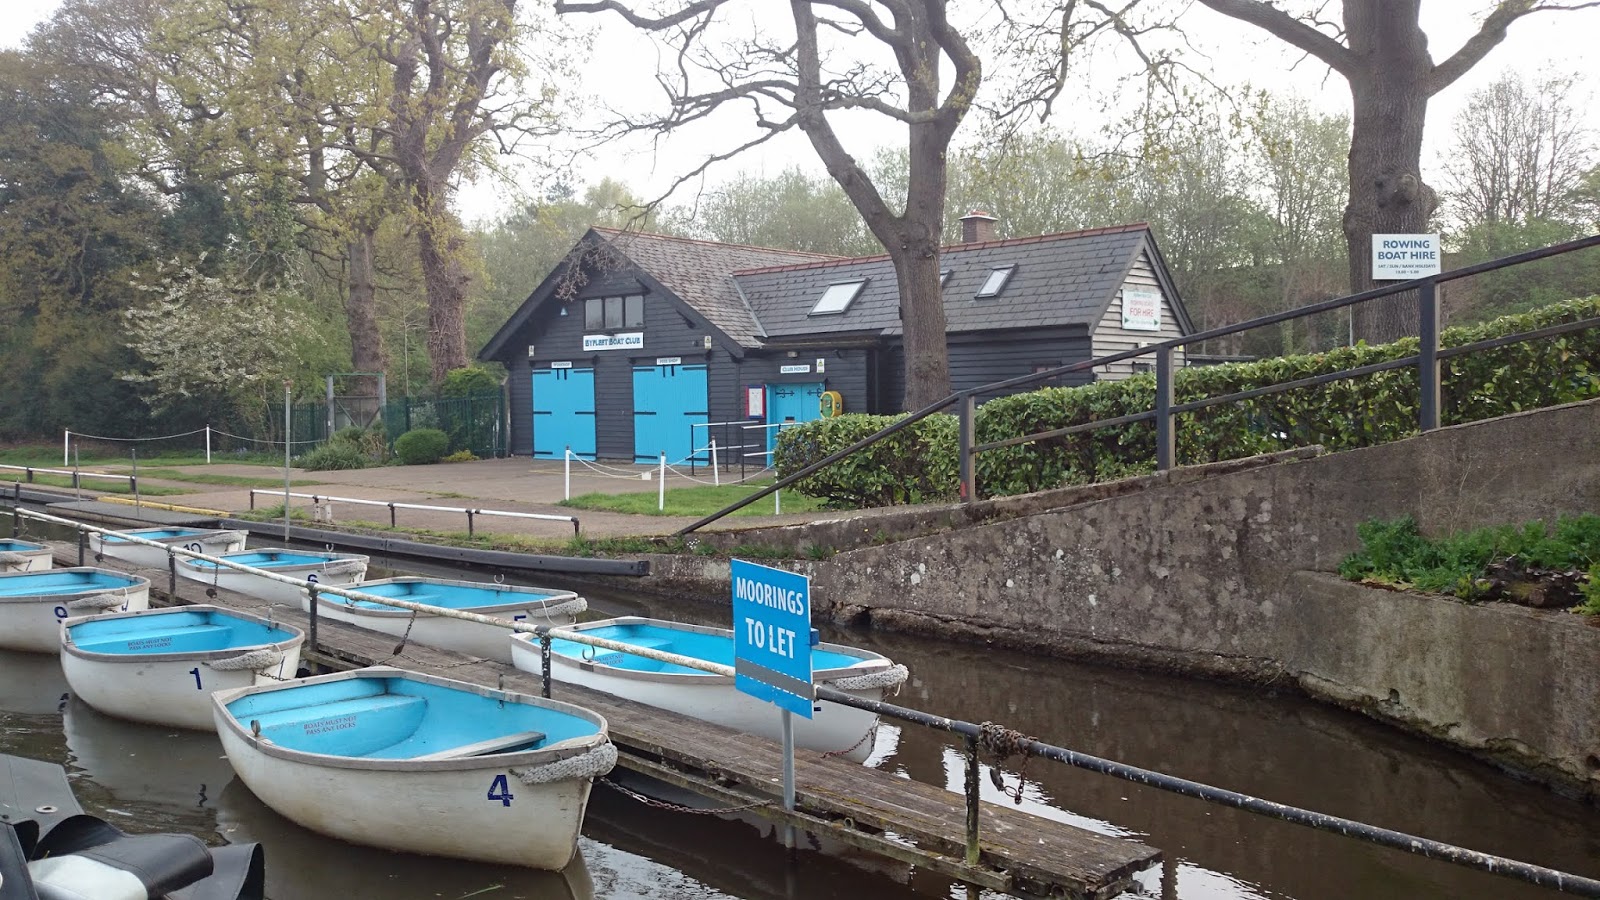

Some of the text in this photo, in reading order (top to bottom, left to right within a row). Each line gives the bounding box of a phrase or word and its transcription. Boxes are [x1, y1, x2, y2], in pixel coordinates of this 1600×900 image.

[1383, 240, 1430, 249] ROWING
[1378, 251, 1436, 260] BOAT HIRE
[1130, 308, 1154, 317] FOR HIRE
[736, 576, 804, 616] MOORINGS
[745, 617, 796, 658] TO LET
[189, 668, 202, 690] 1
[336, 722, 356, 730] LOCKS
[487, 774, 514, 807] 4
